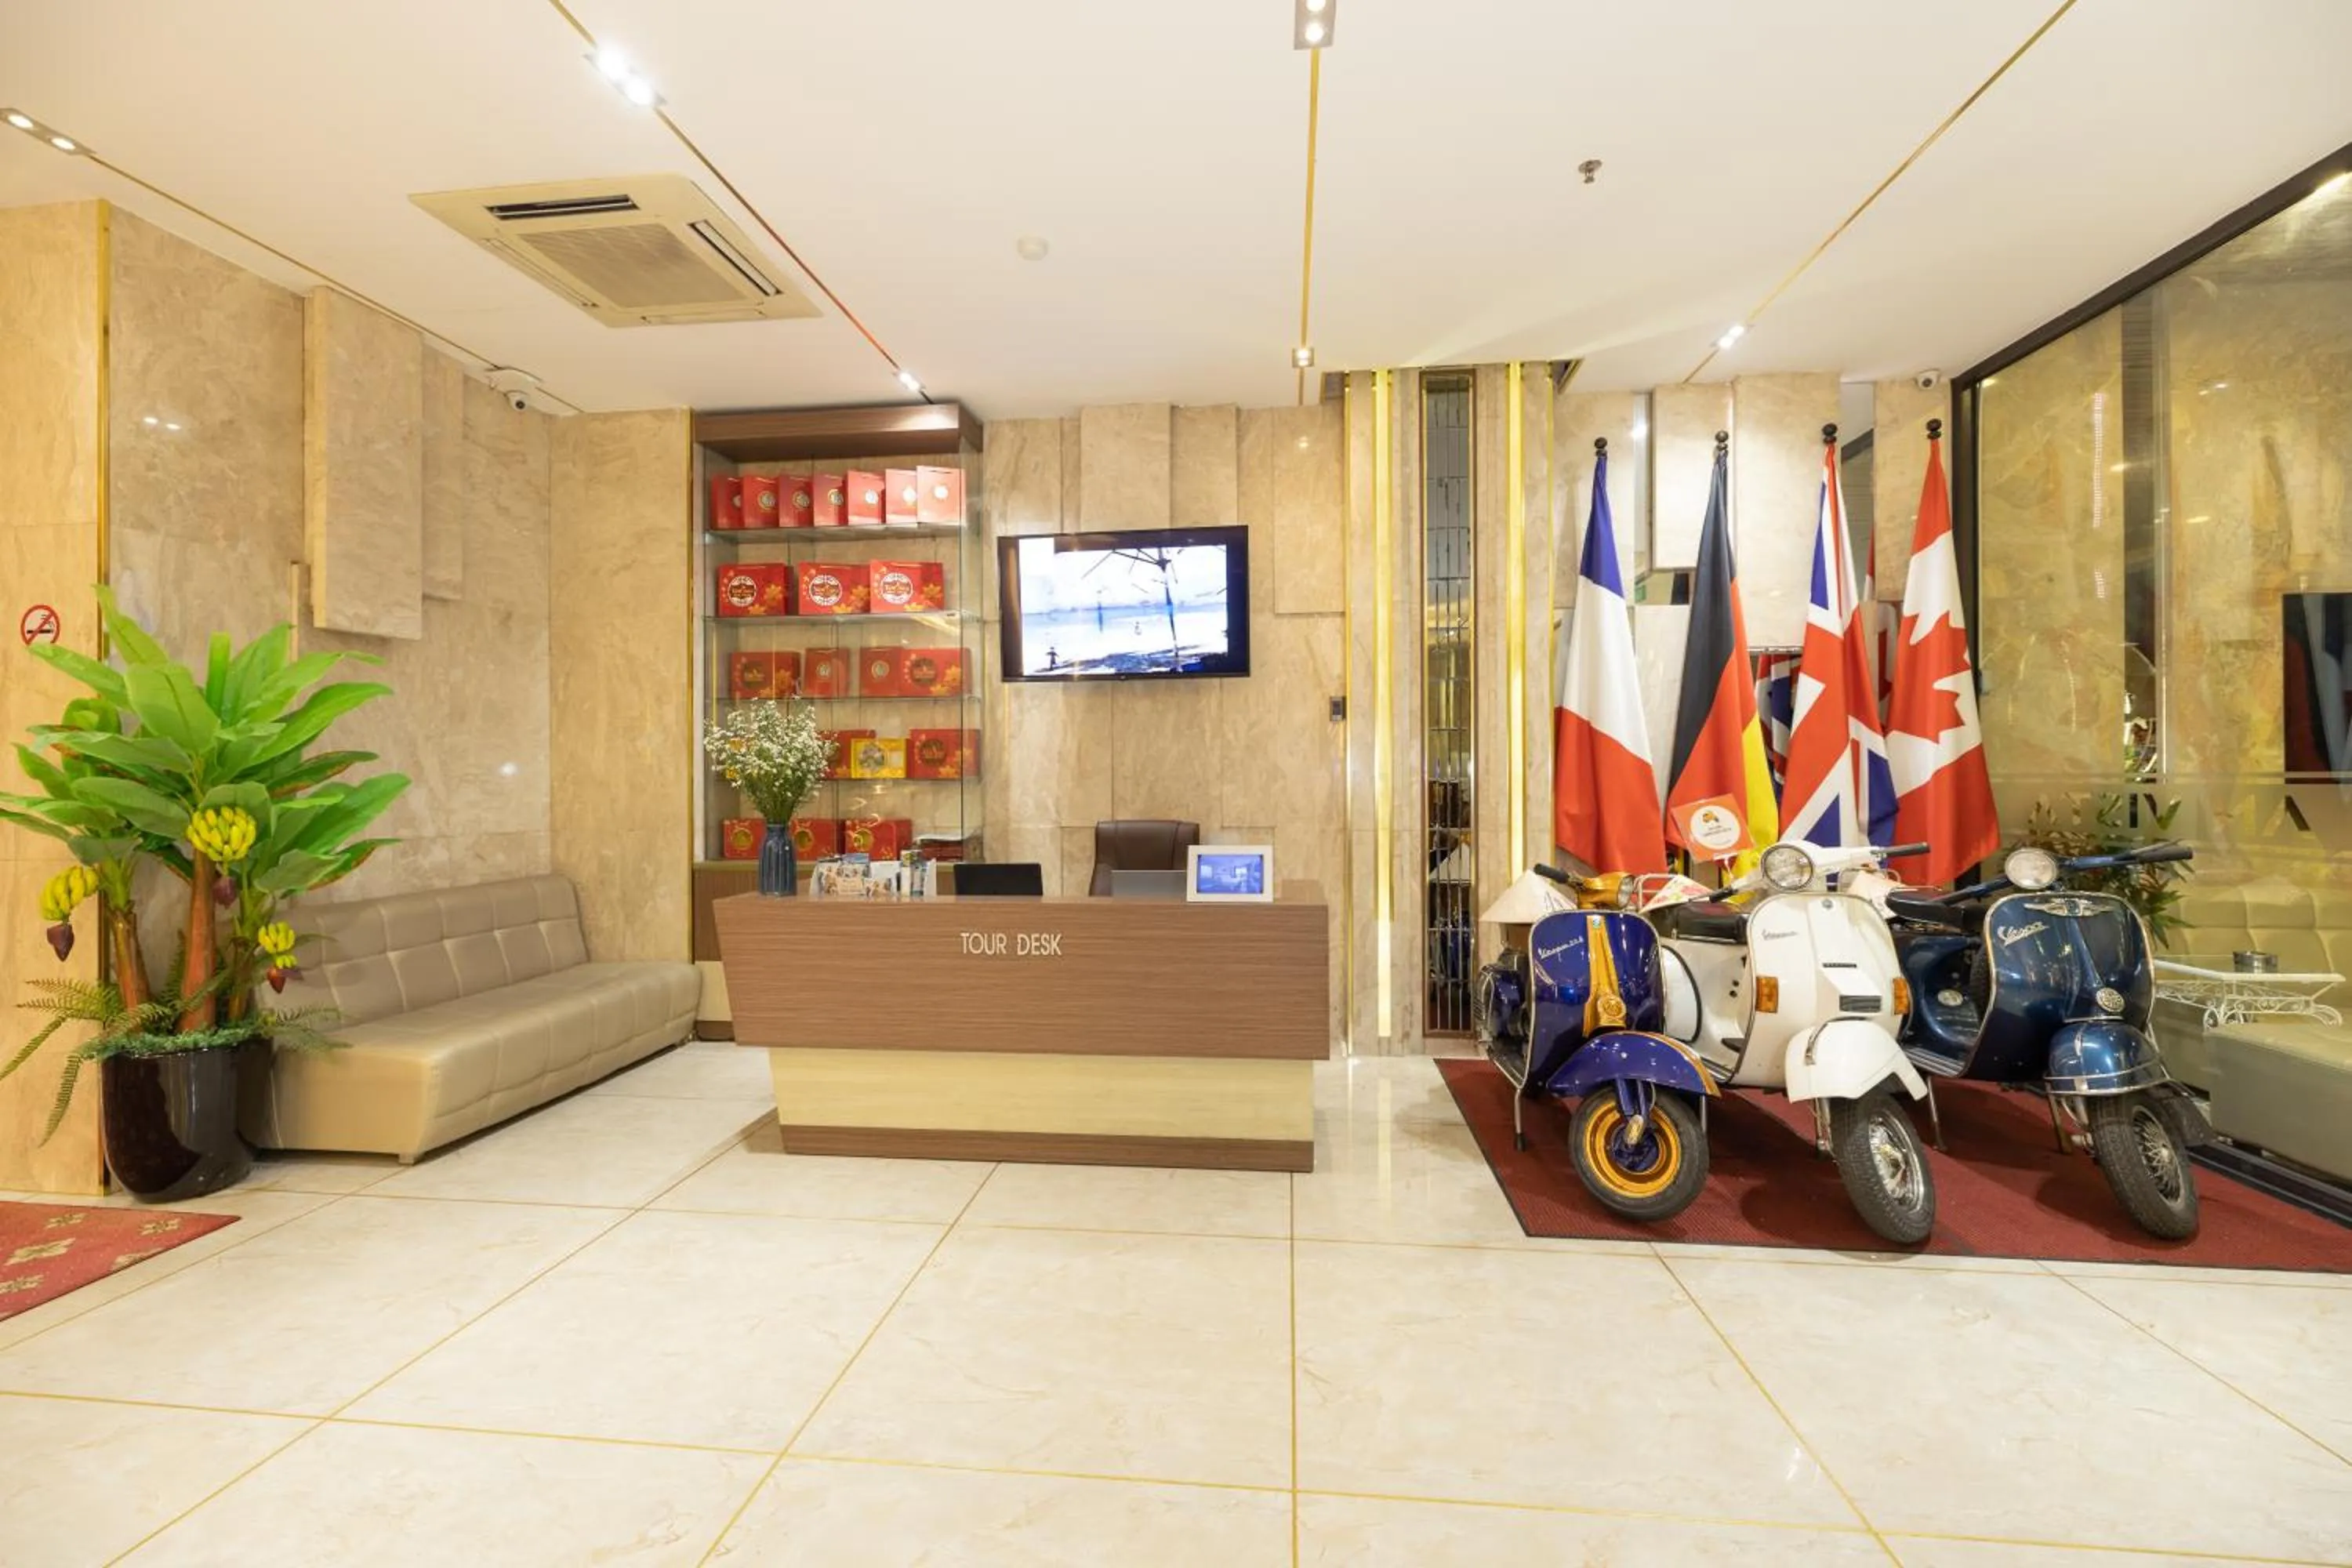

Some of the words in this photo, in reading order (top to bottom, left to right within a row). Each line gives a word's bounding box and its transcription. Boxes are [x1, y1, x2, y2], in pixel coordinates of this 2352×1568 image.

[960, 931, 1007, 955] TOUR
[1017, 933, 1062, 956] DESK
[1997, 920, 2049, 947] Vespa
